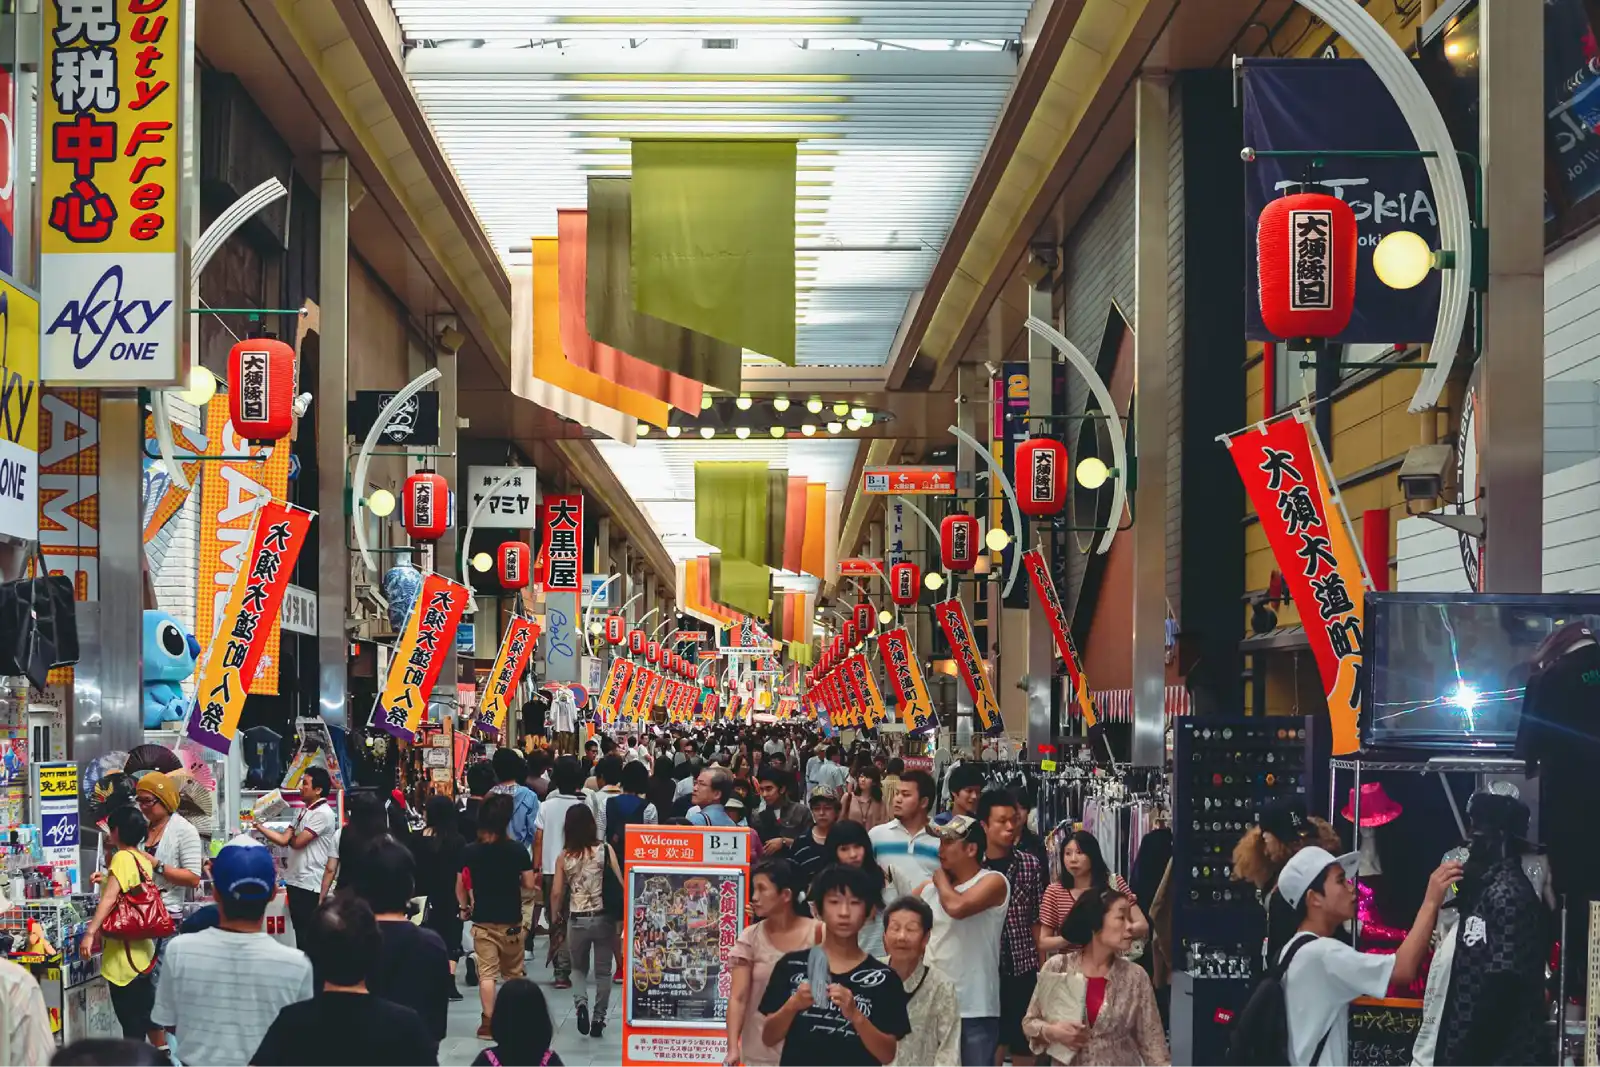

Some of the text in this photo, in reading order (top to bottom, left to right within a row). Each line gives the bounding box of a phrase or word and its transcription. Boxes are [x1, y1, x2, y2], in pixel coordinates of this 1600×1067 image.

[49, 0, 120, 243] 免税中心
[123, 120, 173, 242] Free
[1295, 214, 1328, 305] 大須縁日
[110, 342, 159, 361] ONE
[244, 355, 266, 419] 大須縁日
[473, 493, 530, 515] ヤマミヤ
[1035, 452, 1053, 500] 大須縁日
[549, 500, 579, 589] 大黒屋
[1259, 446, 1362, 738] 大須大道町人
[887, 637, 928, 729] 大須大道町人祭
[945, 609, 1002, 729] 大須大道町人祭
[633, 847, 659, 859] 환영
[640, 834, 689, 846] Welcome
[664, 847, 695, 860] 欢迎
